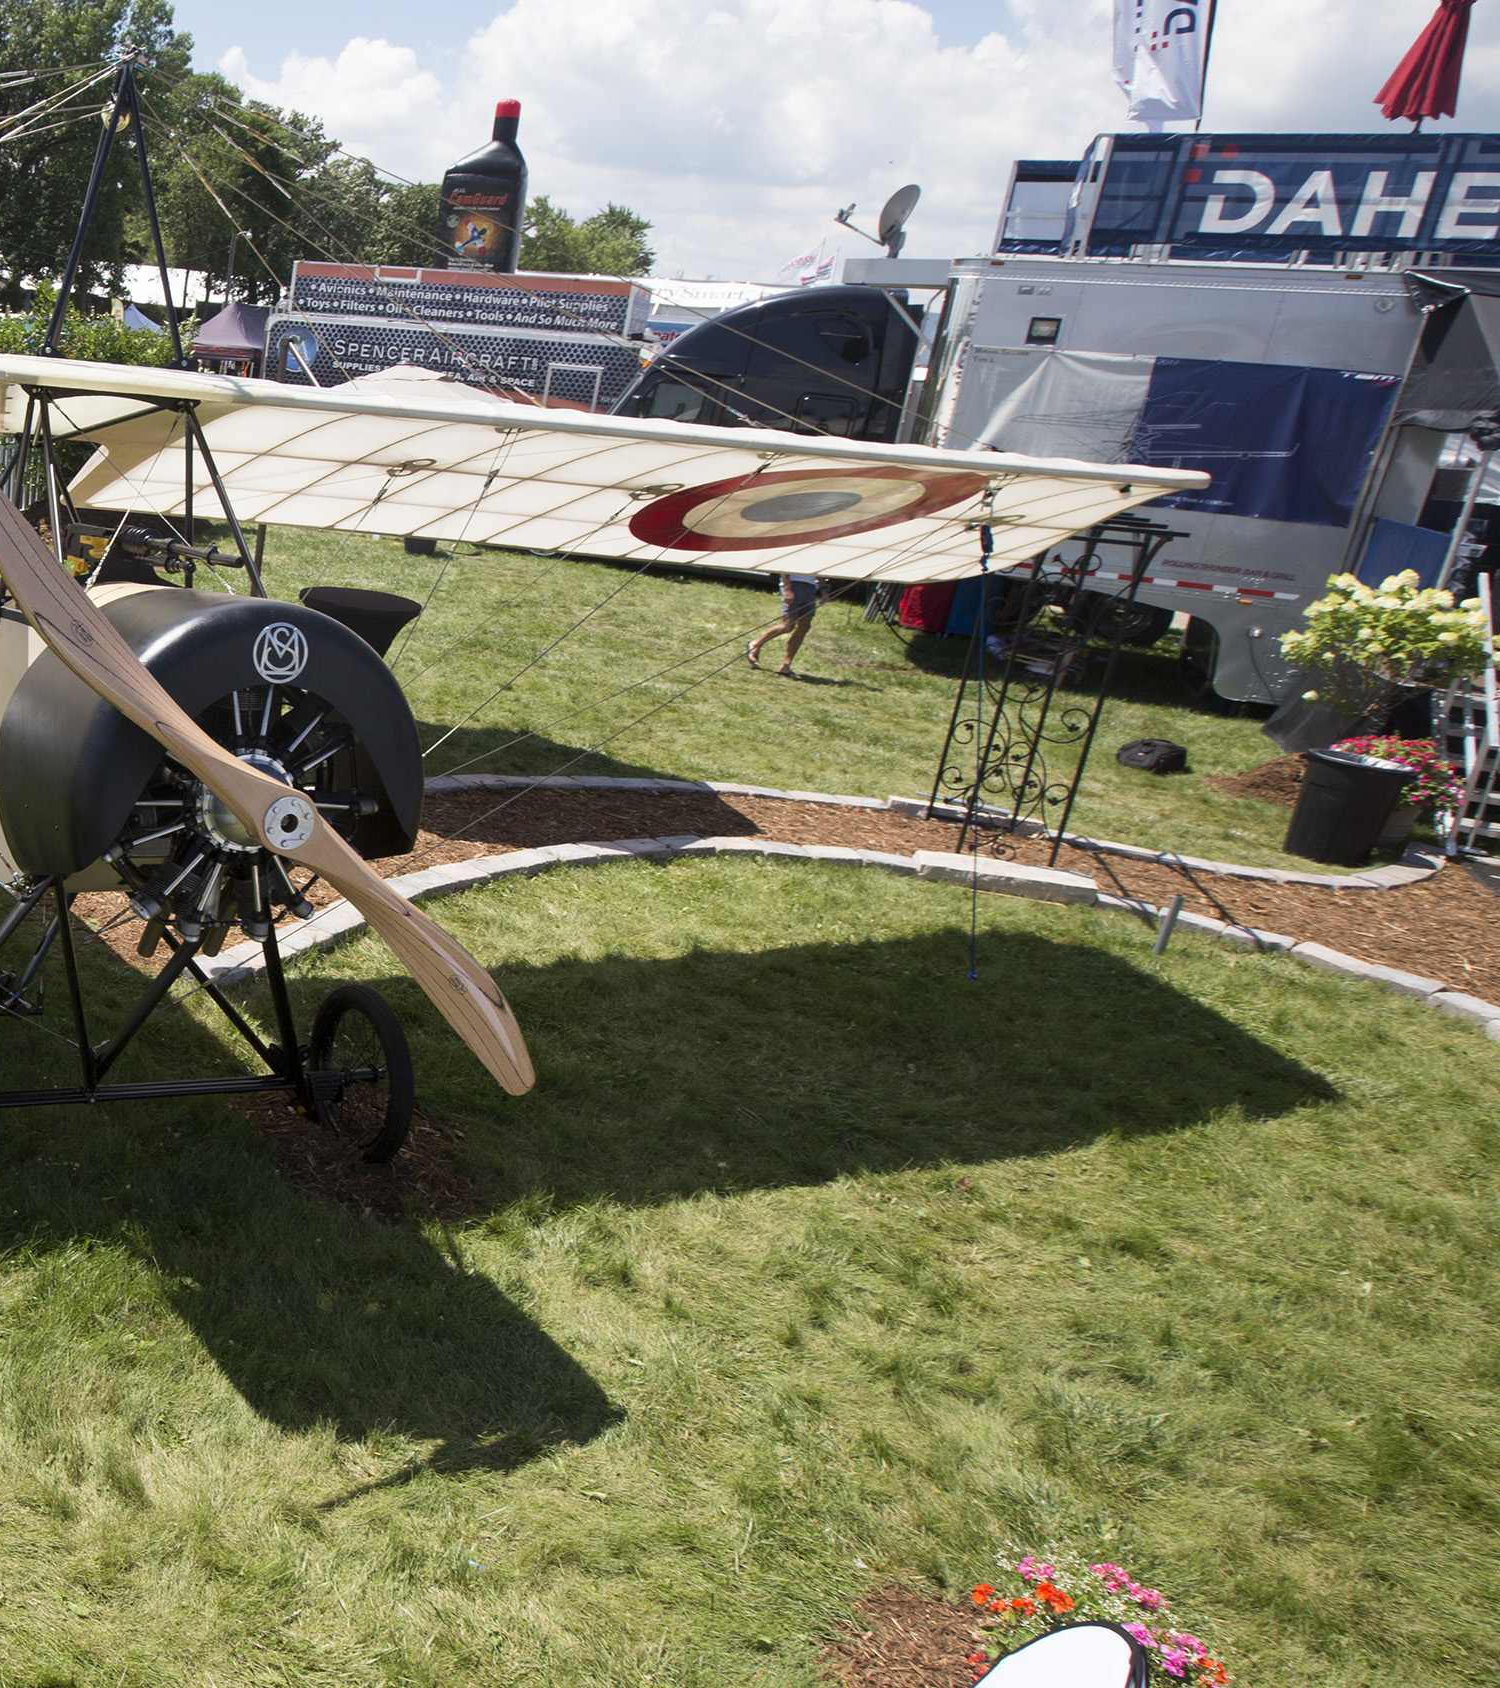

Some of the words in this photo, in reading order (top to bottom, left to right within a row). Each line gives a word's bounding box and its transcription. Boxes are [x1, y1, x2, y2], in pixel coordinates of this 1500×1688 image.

[318, 282, 367, 295] Avionics
[376, 286, 452, 301] Maintenance
[463, 292, 519, 306] Hardware
[529, 296, 557, 308] Pilot
[559, 298, 609, 313] Supplies
[306, 297, 331, 310] Toys
[340, 300, 376, 312] Filters
[385, 303, 403, 314] Oil
[413, 305, 464, 318] Cleaners
[475, 310, 504, 322] Tools
[513, 312, 537, 324] And
[538, 314, 551, 325] So
[553, 315, 585, 329] Much
[587, 318, 618, 330] More
[332, 360, 381, 372] SUPPLIES
[489, 375, 497, 384] &
[500, 376, 535, 387] SPACE
[1161, 559, 1199, 569] ROLLING
[1201, 563, 1242, 574] THUNDER
[1270, 572, 1297, 581] GRILL
